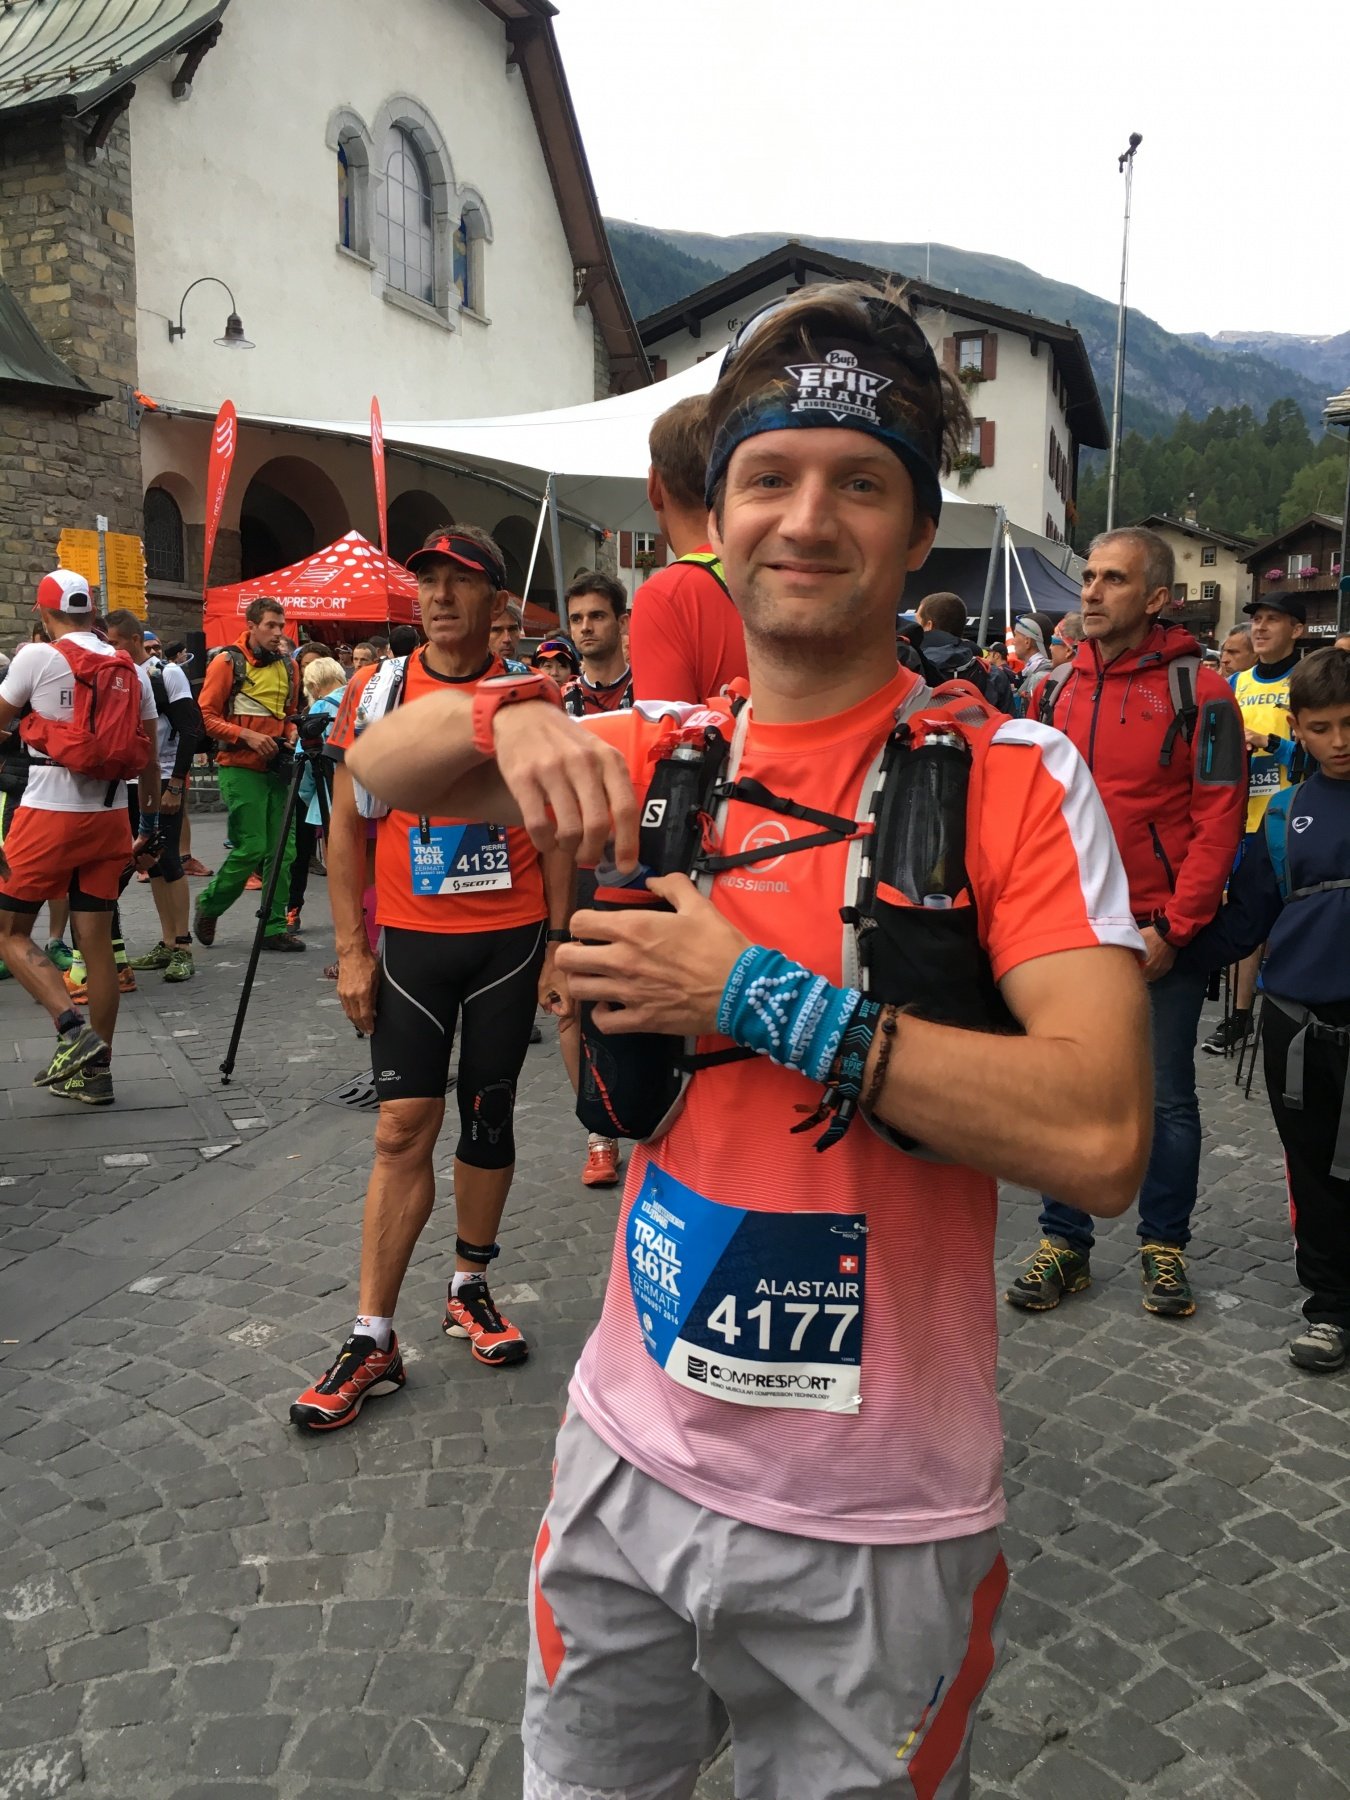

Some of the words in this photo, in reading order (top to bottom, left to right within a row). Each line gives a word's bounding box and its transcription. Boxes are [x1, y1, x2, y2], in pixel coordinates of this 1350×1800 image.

[830, 353, 856, 366] Buff
[800, 368, 879, 398] EPIC
[797, 388, 876, 410] TRAIL
[1308, 625, 1338, 633] RESTAU
[60, 691, 72, 705] FI
[413, 846, 443, 854] TRAIL
[481, 843, 506, 851] PIERRE
[414, 854, 444, 864] 46K
[456, 851, 508, 872] 4132
[462, 879, 498, 887] SCOTT
[634, 1217, 682, 1267] TRAIL
[631, 1243, 681, 1297] 46K
[633, 1270, 680, 1314] ZERMATT
[755, 1279, 859, 1298] ALASTAIR
[663, 1309, 679, 1326] 2016
[707, 1294, 859, 1352] 4177
[725, 1386, 754, 1396] MUSCULAR
[794, 1391, 830, 1399] TECHNOLOGY
